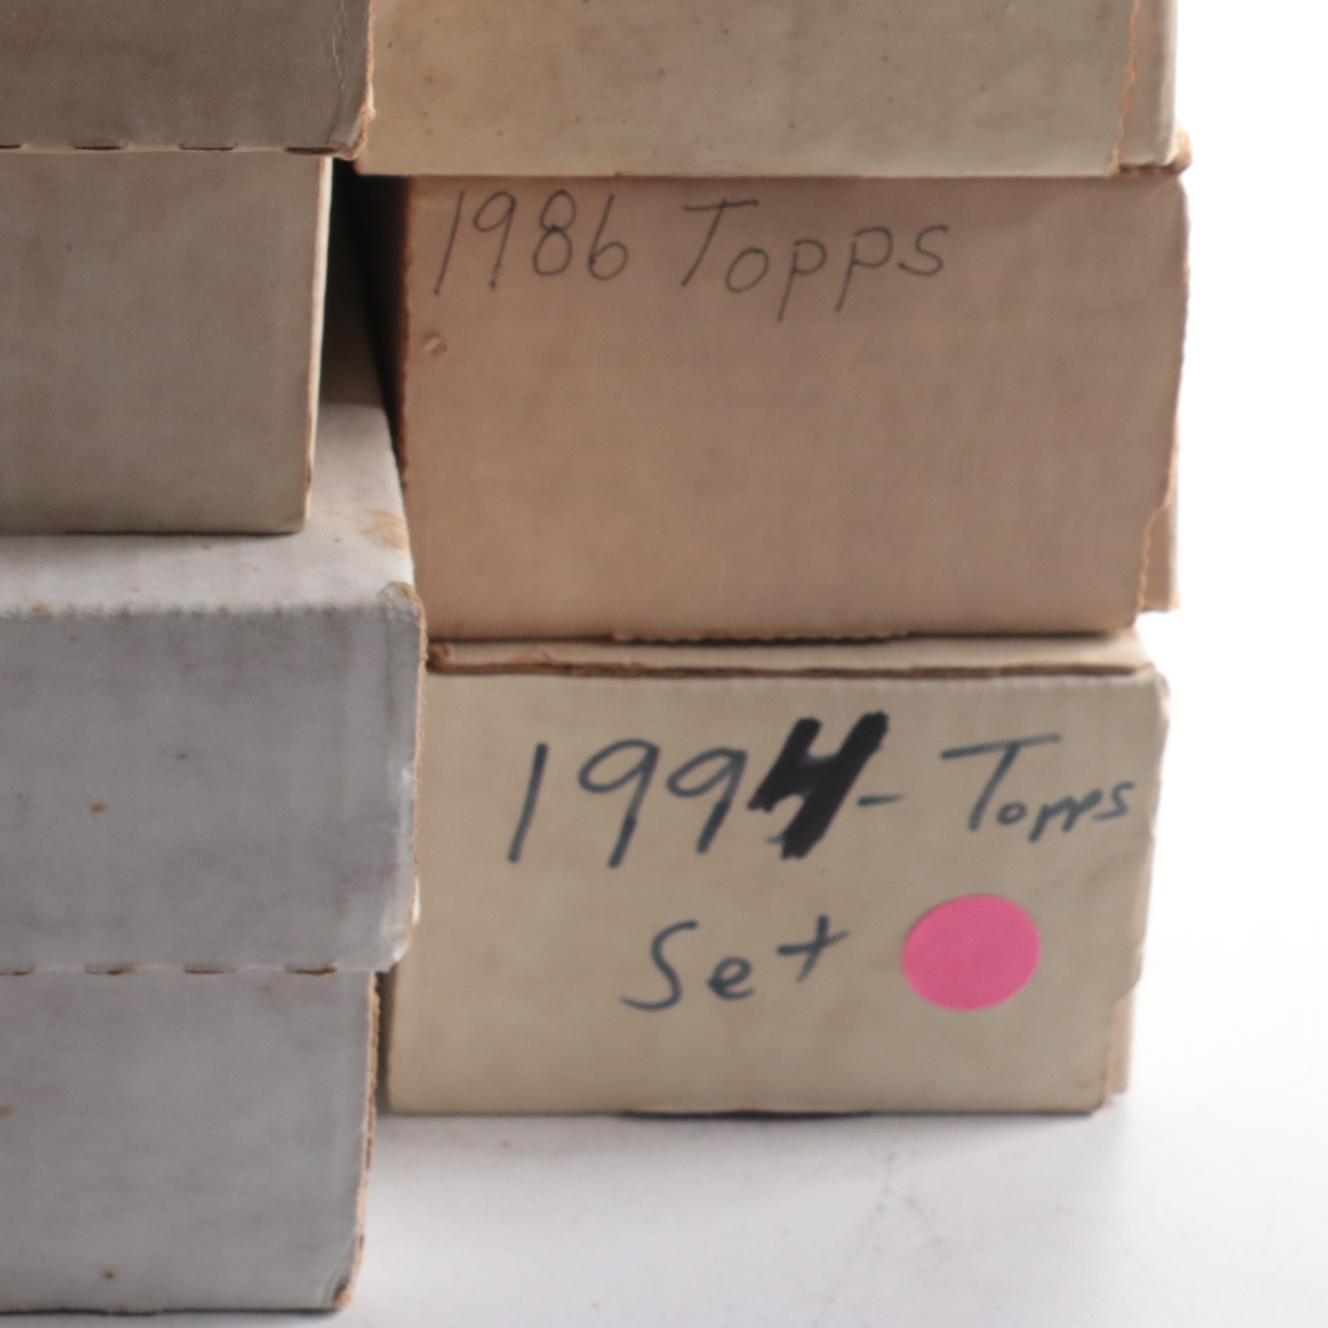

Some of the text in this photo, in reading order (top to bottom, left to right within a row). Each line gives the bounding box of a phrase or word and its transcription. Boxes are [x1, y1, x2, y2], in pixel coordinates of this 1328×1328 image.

[434, 189, 950, 322] 1986 Topps
[940, 733, 1136, 843] Topps
[620, 914, 850, 1011] Set
